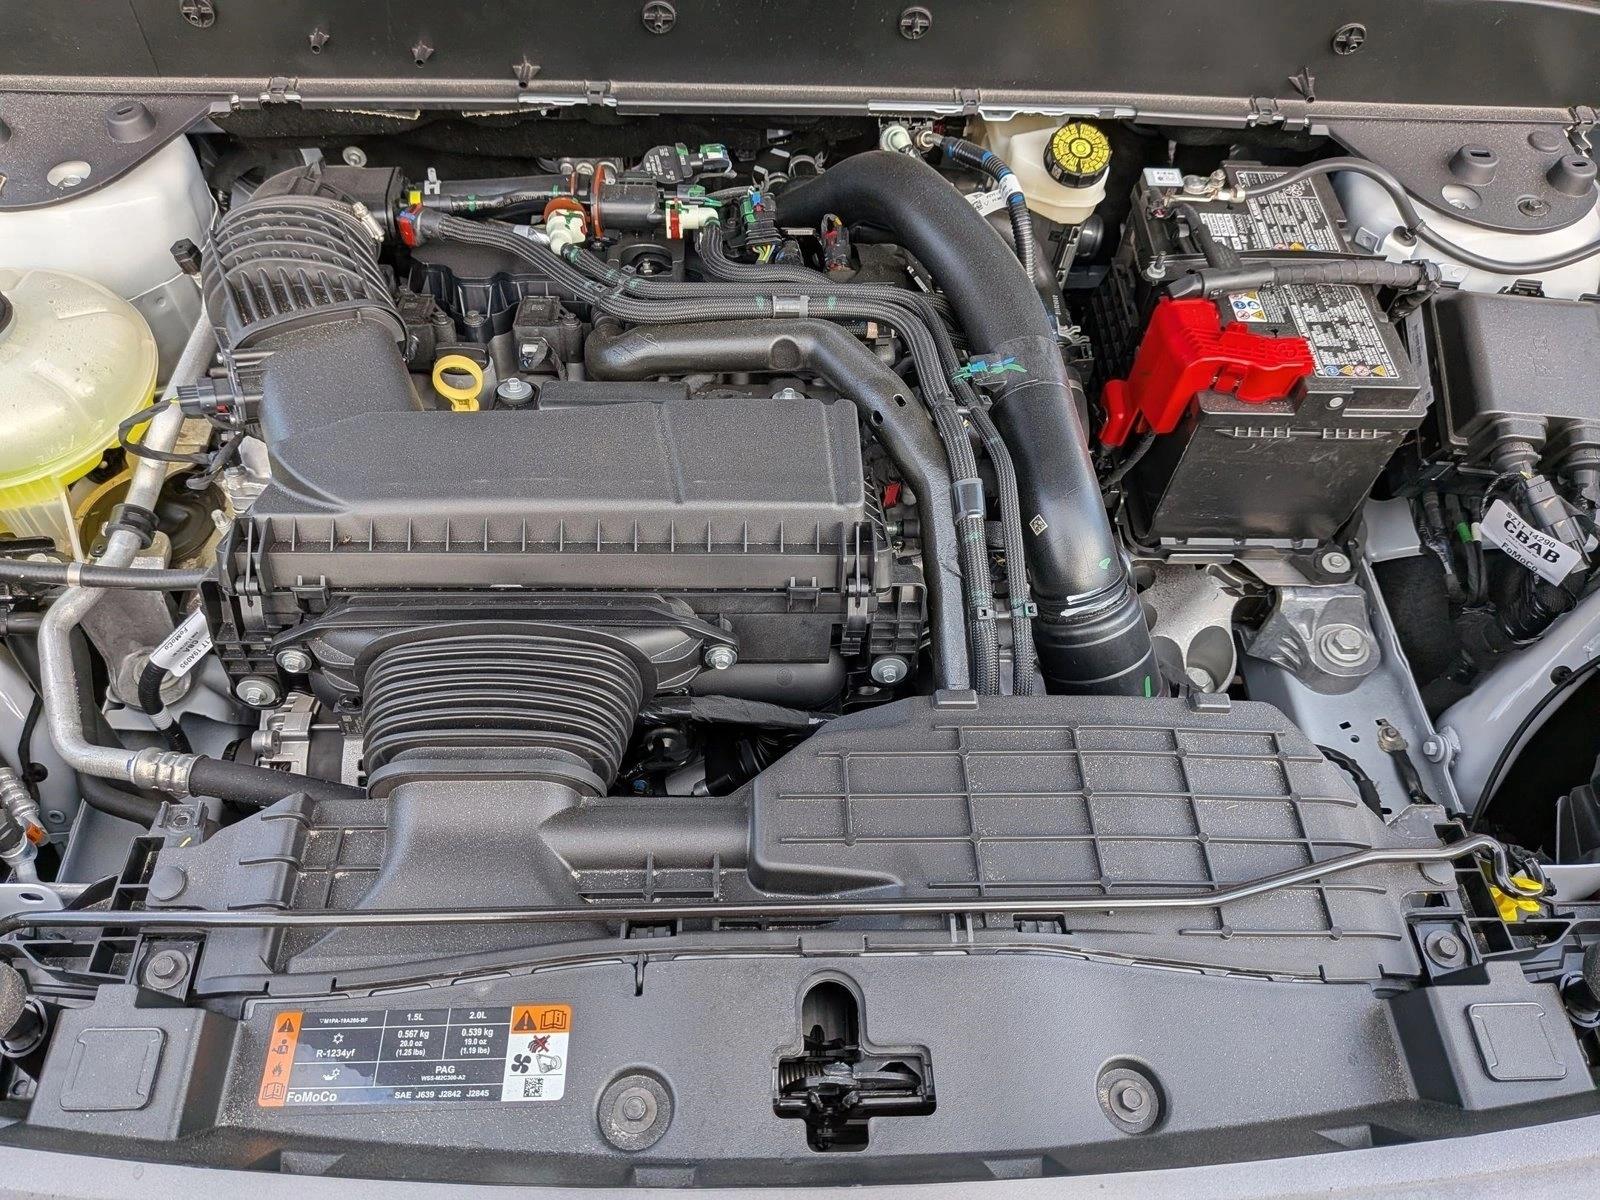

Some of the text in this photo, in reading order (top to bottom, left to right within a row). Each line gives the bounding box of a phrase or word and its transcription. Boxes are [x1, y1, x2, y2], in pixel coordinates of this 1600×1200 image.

[1503, 519, 1561, 563] CBAB
[1529, 531, 1556, 549] 14290
[1501, 542, 1538, 572] FoMoCo
[164, 627, 189, 651] FoMoCo
[180, 648, 201, 669] 19A095
[406, 1013, 424, 1021] 1.5L
[468, 1011, 488, 1019] 2.0L
[397, 1029, 430, 1039] 0.567 kg
[461, 1028, 494, 1037] 0.539 kg
[316, 1048, 356, 1059] R-1234yf
[412, 1048, 426, 1057] lbs)
[477, 1046, 490, 1055] lbs)
[435, 1065, 455, 1074] PAG
[286, 1091, 338, 1102] FoMoCo
[394, 1091, 412, 1099] SAE
[415, 1090, 435, 1098] J639
